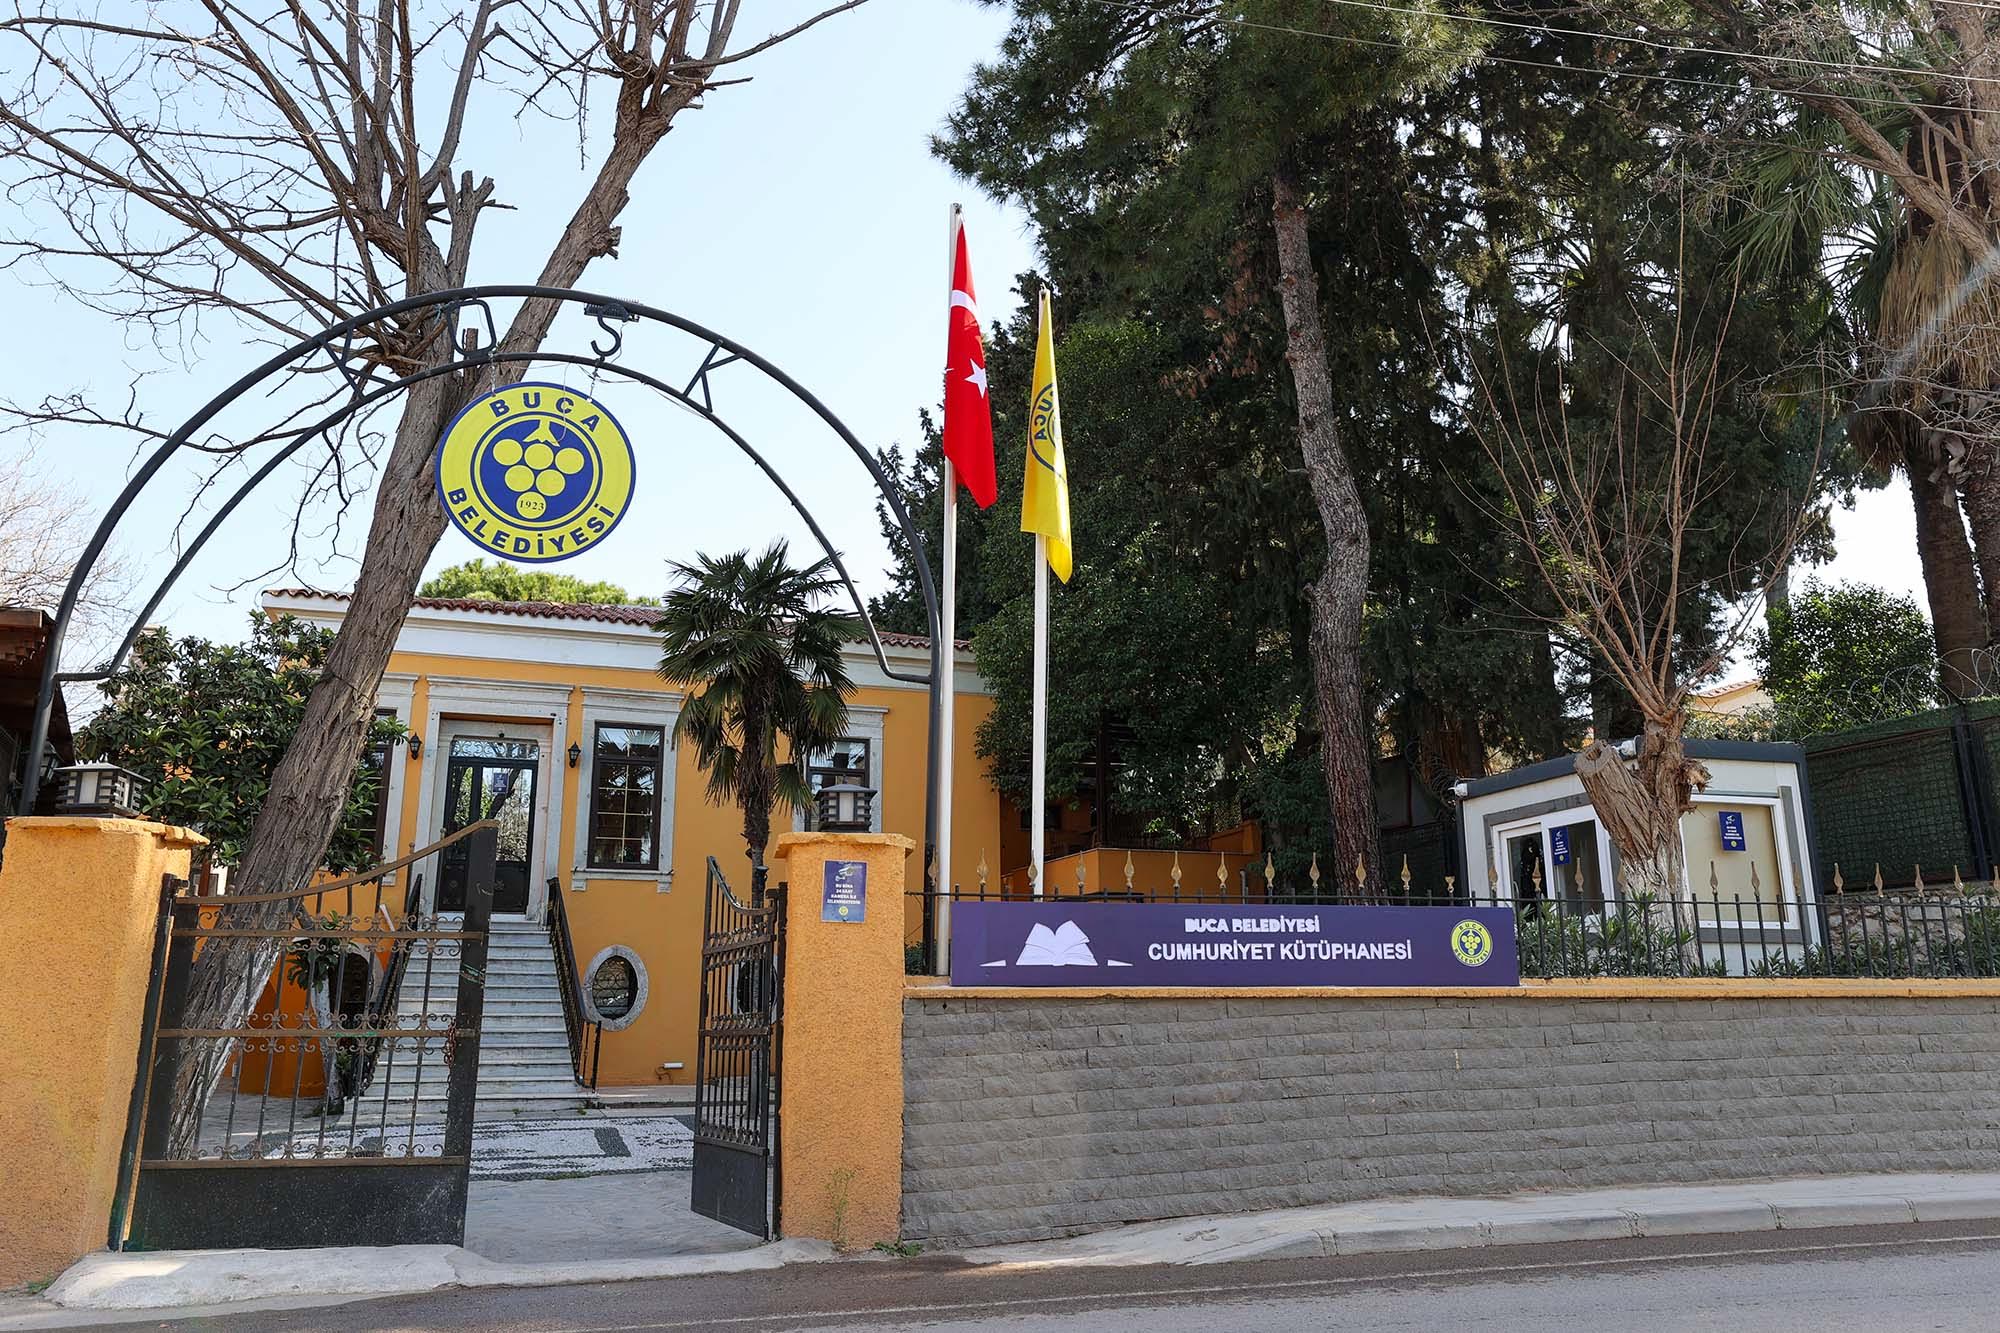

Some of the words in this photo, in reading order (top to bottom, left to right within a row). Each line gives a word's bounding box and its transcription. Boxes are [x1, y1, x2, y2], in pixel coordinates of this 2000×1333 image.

[489, 392, 600, 432] BUCA
[519, 499, 545, 511] 1923
[447, 487, 615, 555] BELEDİYESİ
[1185, 918, 1230, 933] BUCA
[1231, 914, 1320, 933] BELEDİYESİ
[1458, 922, 1483, 931] BUCA
[1148, 939, 1275, 960] CUMHURİYET
[1280, 939, 1412, 960] KÜTÜPHANESİ
